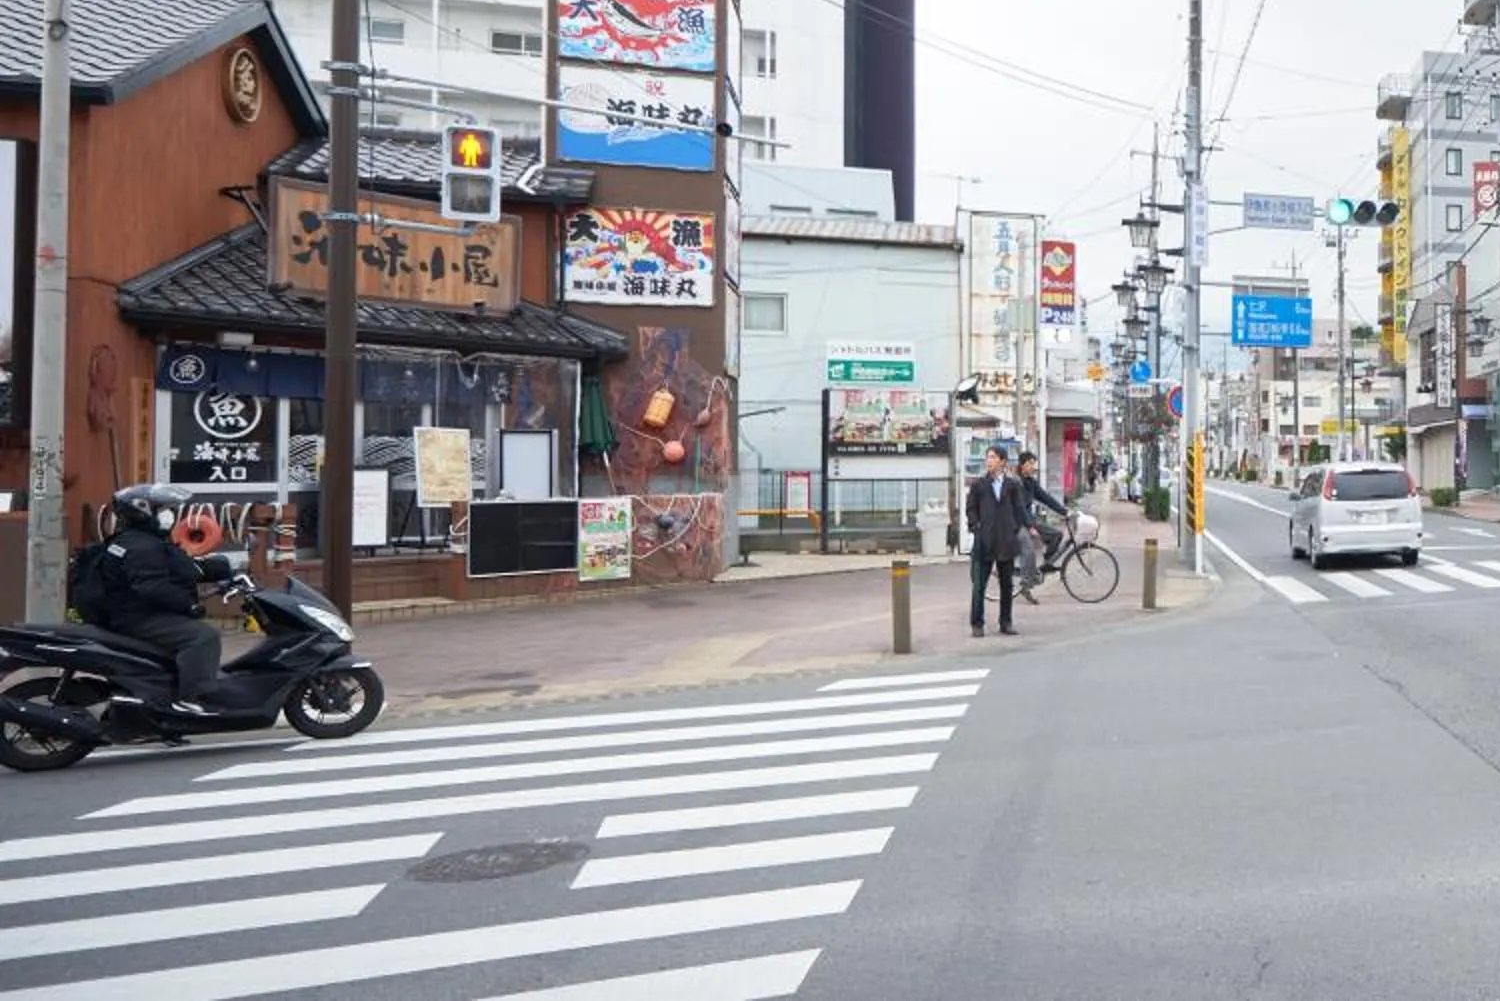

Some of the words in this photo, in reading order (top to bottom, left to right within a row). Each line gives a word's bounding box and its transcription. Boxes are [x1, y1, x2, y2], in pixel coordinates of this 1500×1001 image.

[569, 214, 599, 243] 大
[623, 275, 697, 298] 海味丸
[208, 466, 247, 481] 入口
